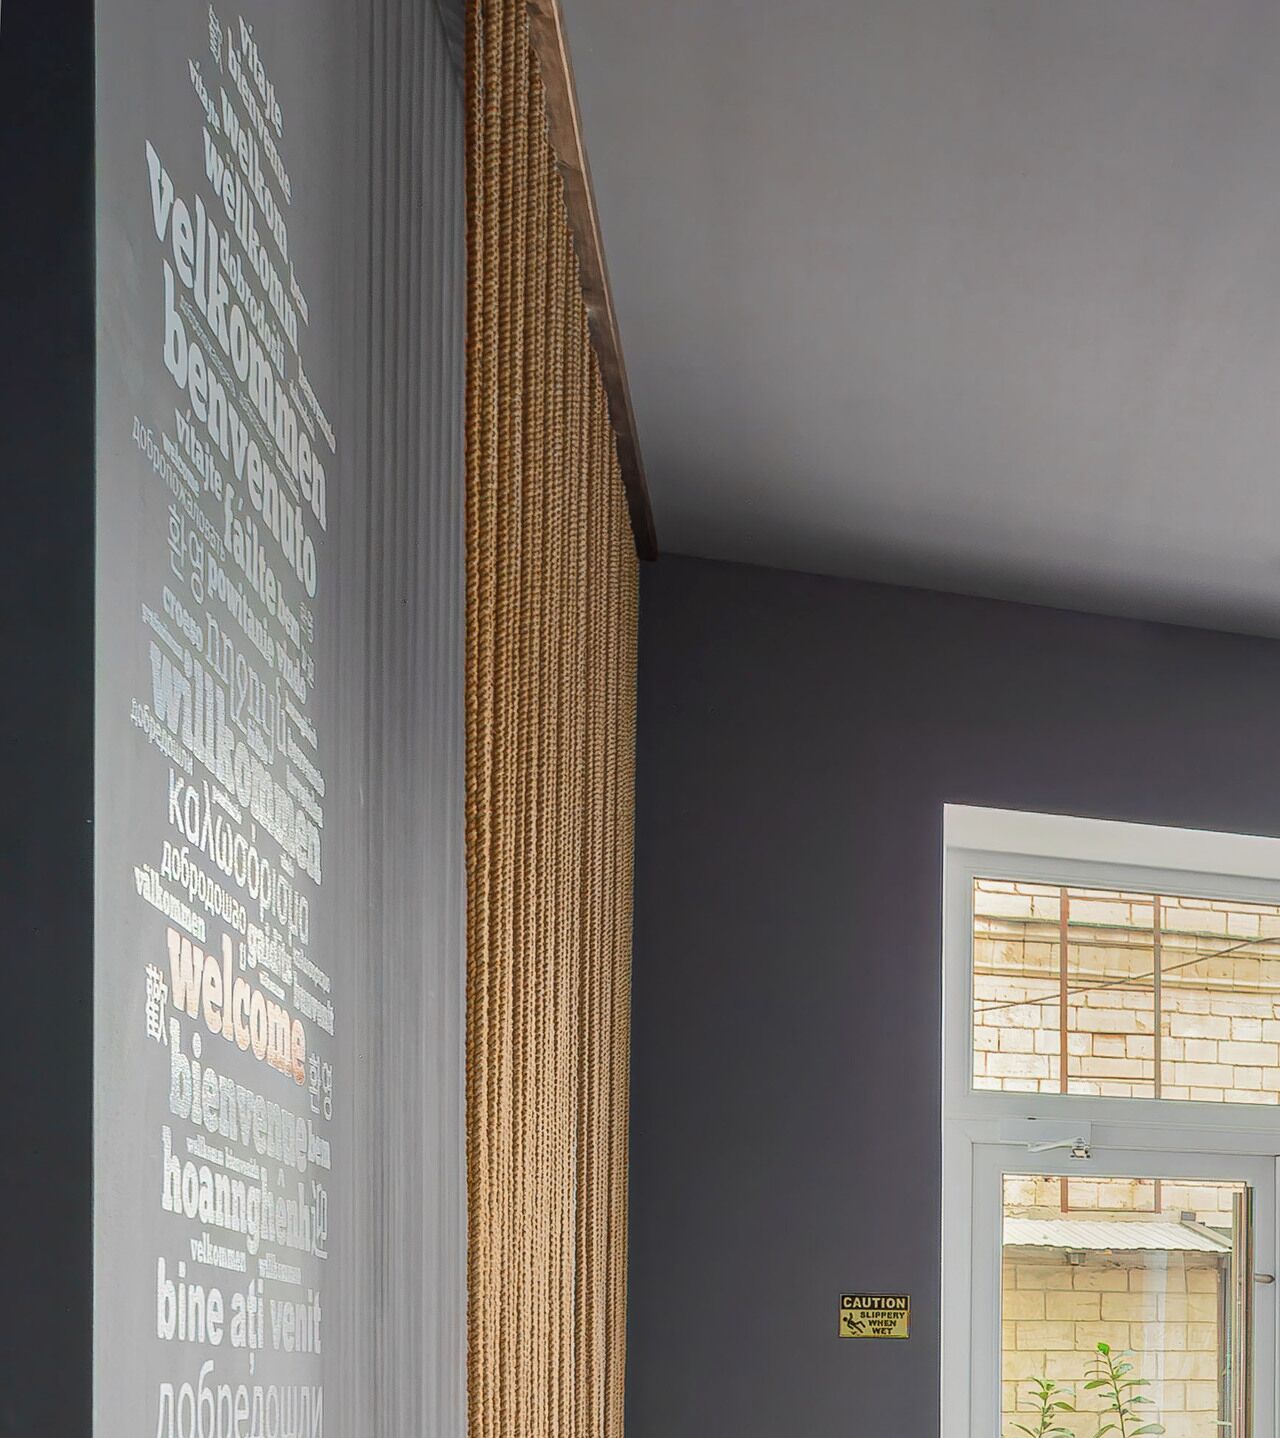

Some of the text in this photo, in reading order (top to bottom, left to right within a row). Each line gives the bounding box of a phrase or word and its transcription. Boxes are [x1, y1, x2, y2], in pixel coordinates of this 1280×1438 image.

[145, 138, 326, 532] velkommen
[162, 257, 317, 598] benvenuto
[150, 640, 321, 886] willkommen
[167, 926, 306, 1086] welcome
[169, 1016, 307, 1173] bienvenue
[157, 1256, 224, 1346] bine
[270, 1288, 322, 1354] venit
[843, 1296, 906, 1309] CAUTION
[860, 1311, 905, 1319] SLIPPERY
